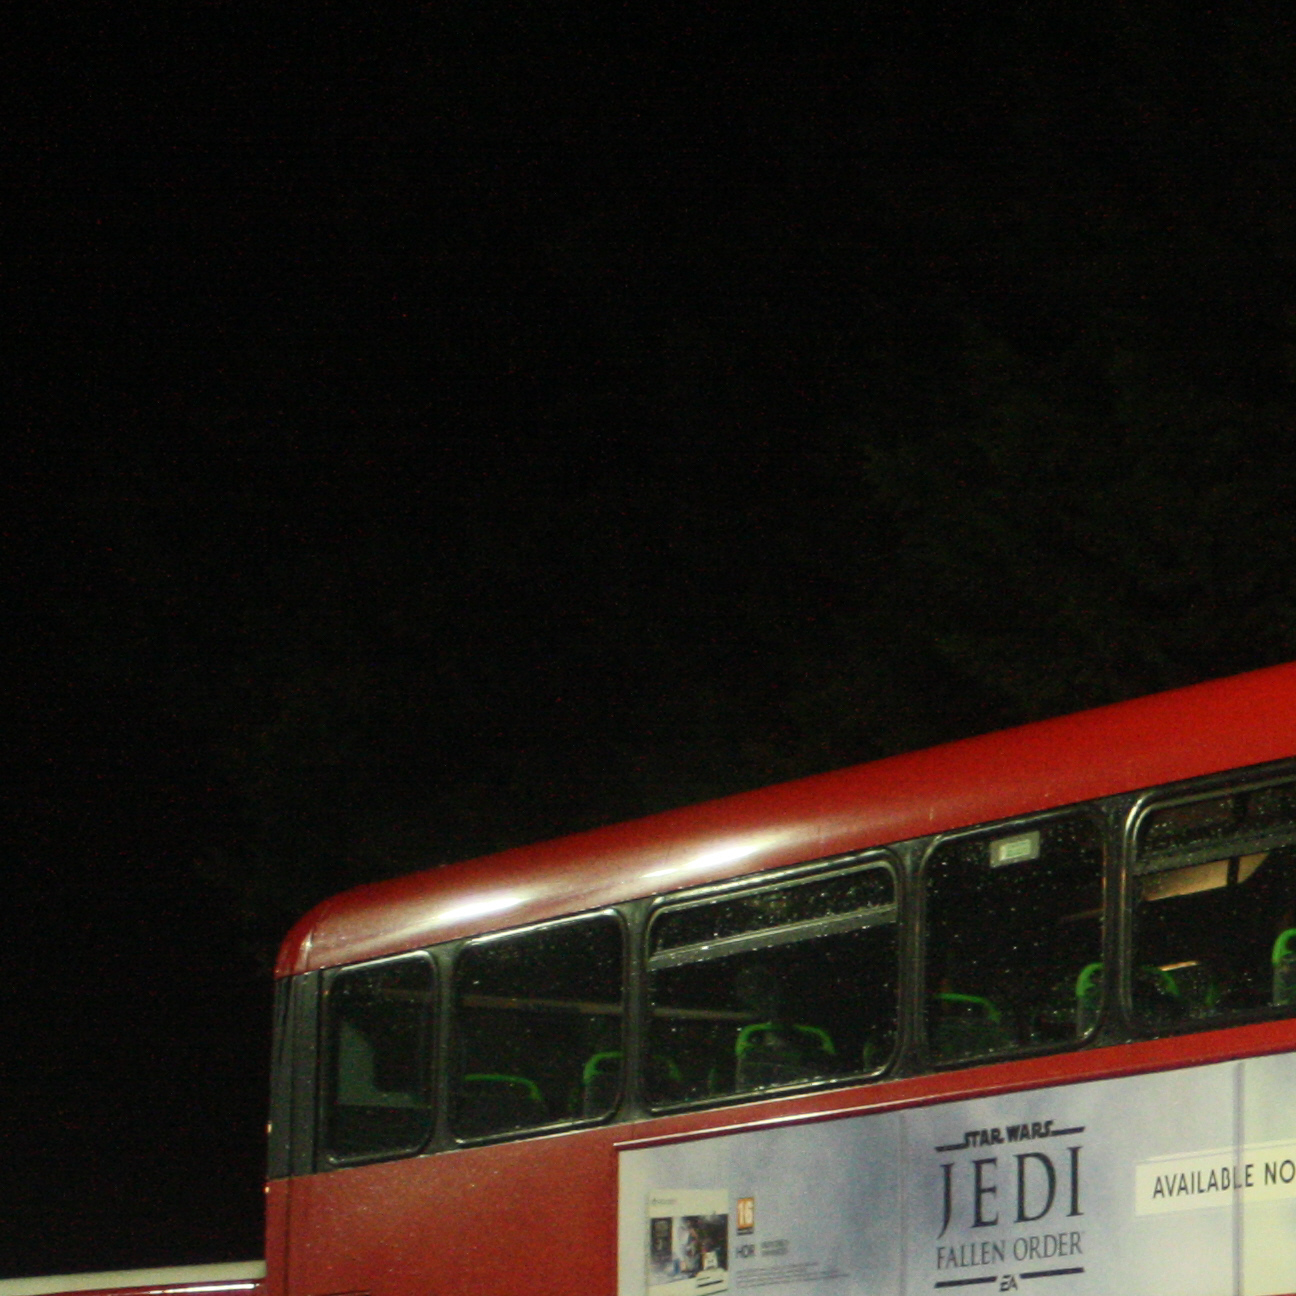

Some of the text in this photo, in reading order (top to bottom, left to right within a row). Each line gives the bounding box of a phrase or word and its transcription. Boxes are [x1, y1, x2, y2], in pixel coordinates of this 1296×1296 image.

[962, 1119, 1054, 1149] STAR WARS
[936, 1146, 1084, 1239] JEDI
[1152, 1163, 1254, 1199] AVAILABLE
[936, 1230, 1084, 1271] FALLEN ORDER
